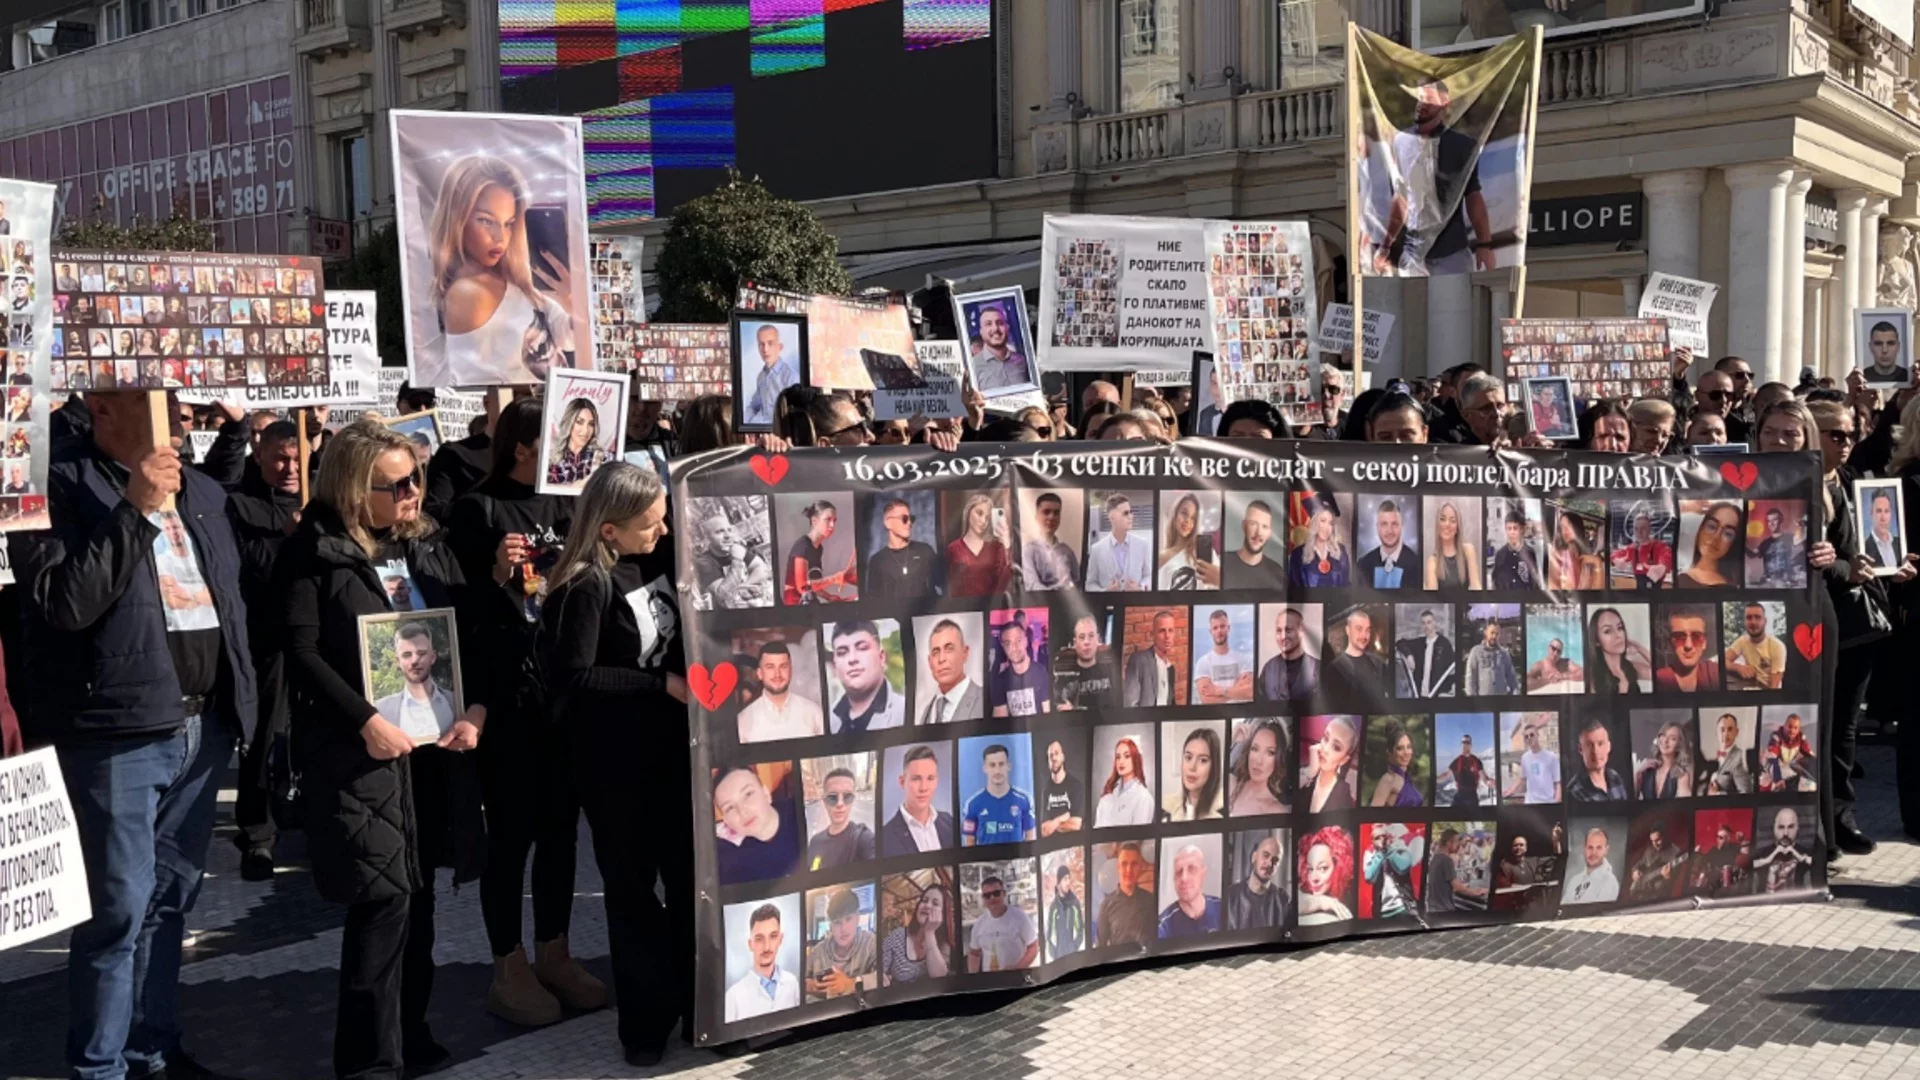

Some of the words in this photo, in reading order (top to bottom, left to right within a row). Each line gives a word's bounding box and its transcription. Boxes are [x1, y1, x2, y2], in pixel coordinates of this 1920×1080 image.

[103, 160, 177, 199] OFFICE
[186, 145, 258, 184] SPACE
[232, 183, 268, 216] 389
[1157, 241, 1182, 252] НИЕ
[1129, 259, 1206, 273] РОДИТЕЛИТЕ
[1147, 279, 1187, 290] СКАПО
[342, 302, 365, 321] ДА
[1124, 298, 1139, 309] ГО
[1142, 298, 1206, 311] ПЛАТИВМЕ
[1126, 316, 1183, 330] ДАНОКОТ
[1185, 318, 1201, 329] НА
[1120, 336, 1204, 349] КОРУПЦИЈАТА
[245, 382, 342, 401] СЕМЕЈСТВА
[842, 454, 1002, 483] 16.03.2025
[1032, 449, 1063, 480] 63
[1070, 454, 1156, 478] сенки
[1200, 457, 1231, 478] ве
[1236, 457, 1326, 483] следат
[1352, 454, 1419, 488] секој
[1426, 463, 1511, 489] поглед
[1516, 460, 1570, 493] бара
[1576, 463, 1690, 493] ПРАВДА
[8, 806, 41, 847] ВЕЧНА
[13, 894, 34, 933] БЕЗ
